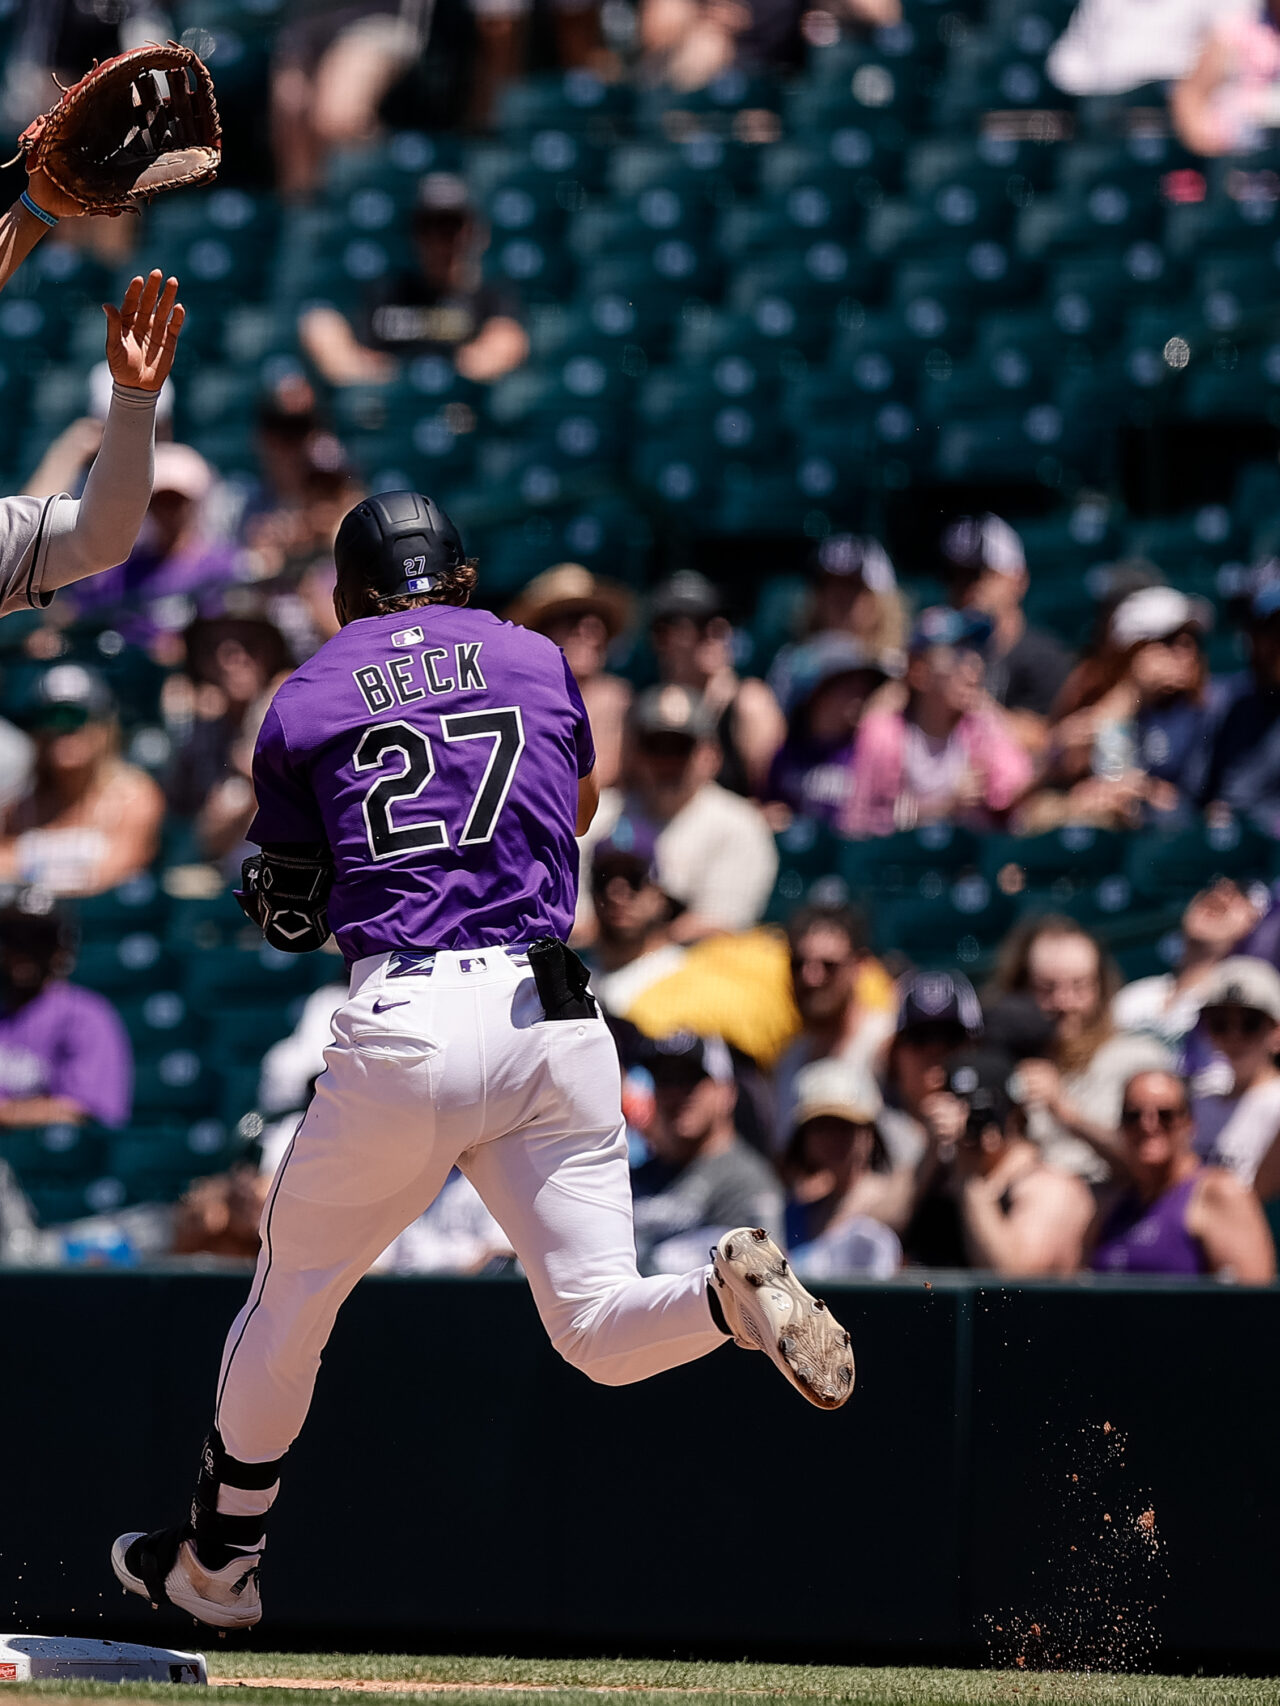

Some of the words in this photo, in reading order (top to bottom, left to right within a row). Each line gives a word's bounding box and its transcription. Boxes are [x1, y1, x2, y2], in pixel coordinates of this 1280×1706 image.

[403, 555, 426, 576] 27
[352, 642, 487, 716] BECK
[352, 705, 526, 861] 27
